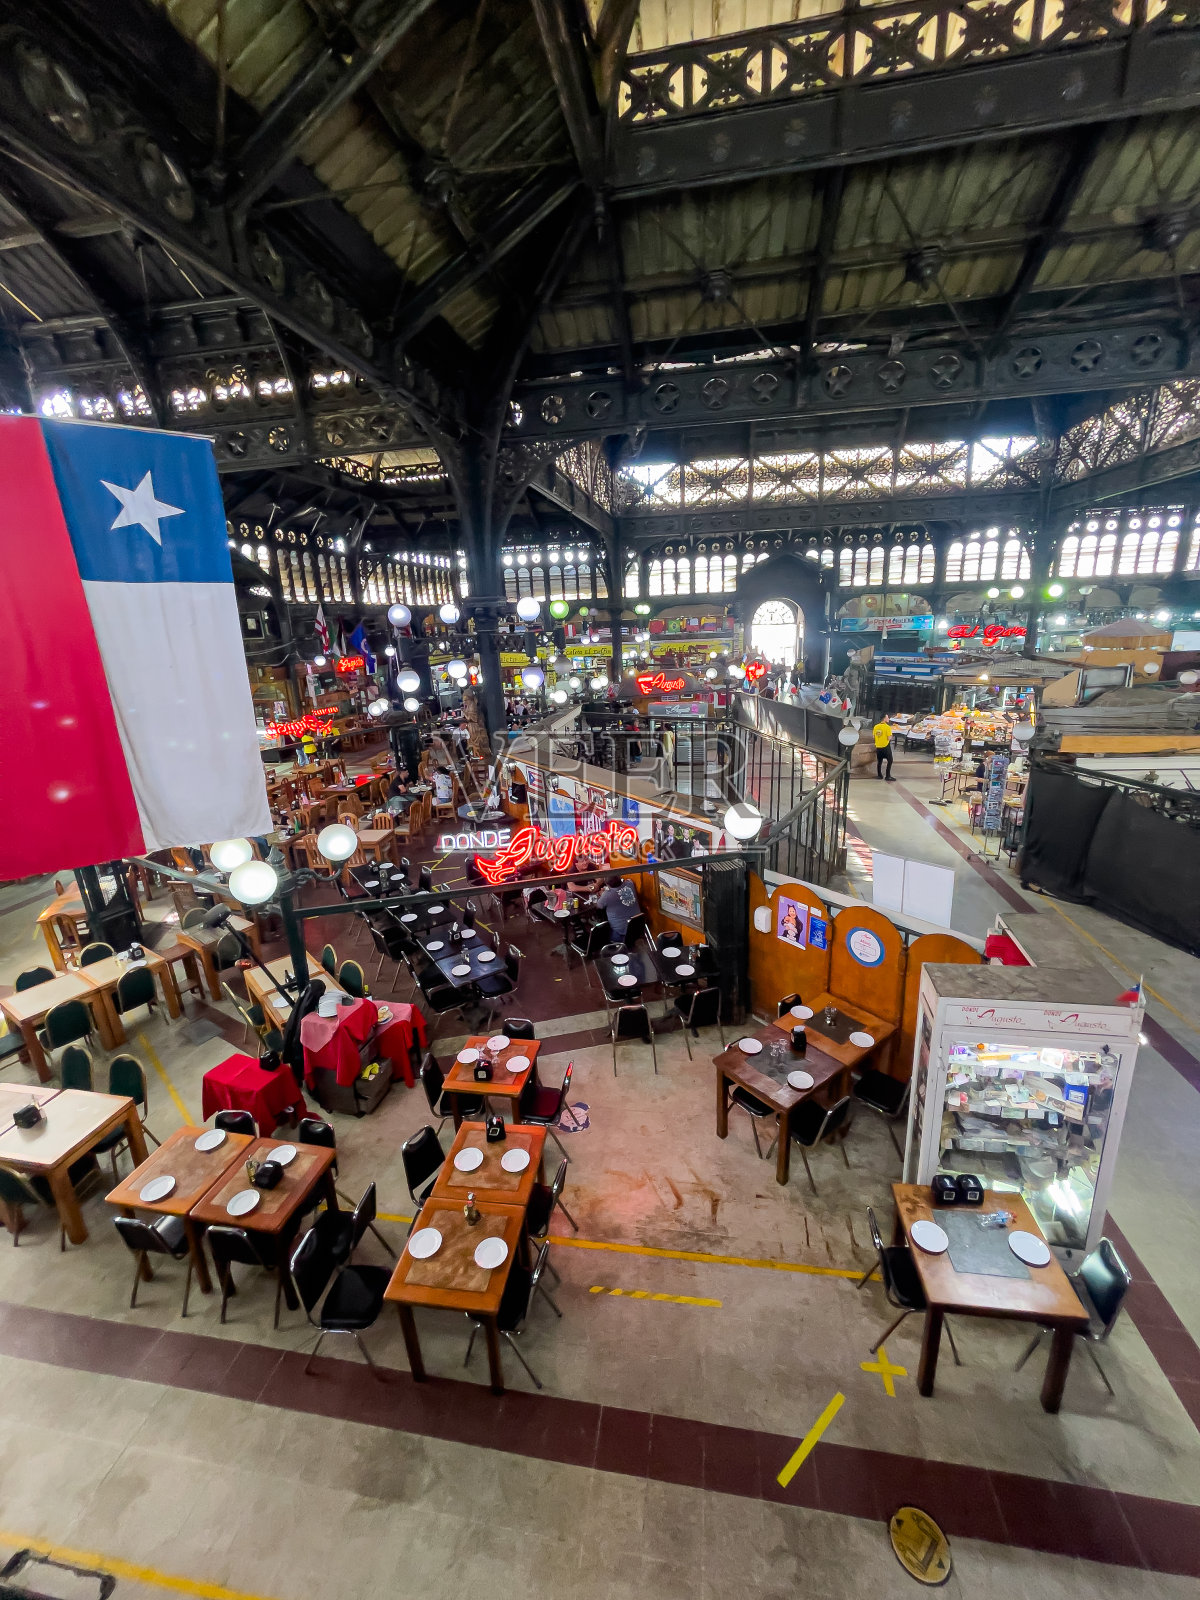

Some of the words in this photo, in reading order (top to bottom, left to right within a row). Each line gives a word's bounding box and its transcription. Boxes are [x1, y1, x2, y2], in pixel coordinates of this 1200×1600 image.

[947, 624, 980, 638] El
[440, 828, 511, 852] DONDE
[495, 820, 639, 872] Augusto
[977, 1008, 1023, 1026] Augusto
[1059, 1013, 1108, 1031] Augusto
